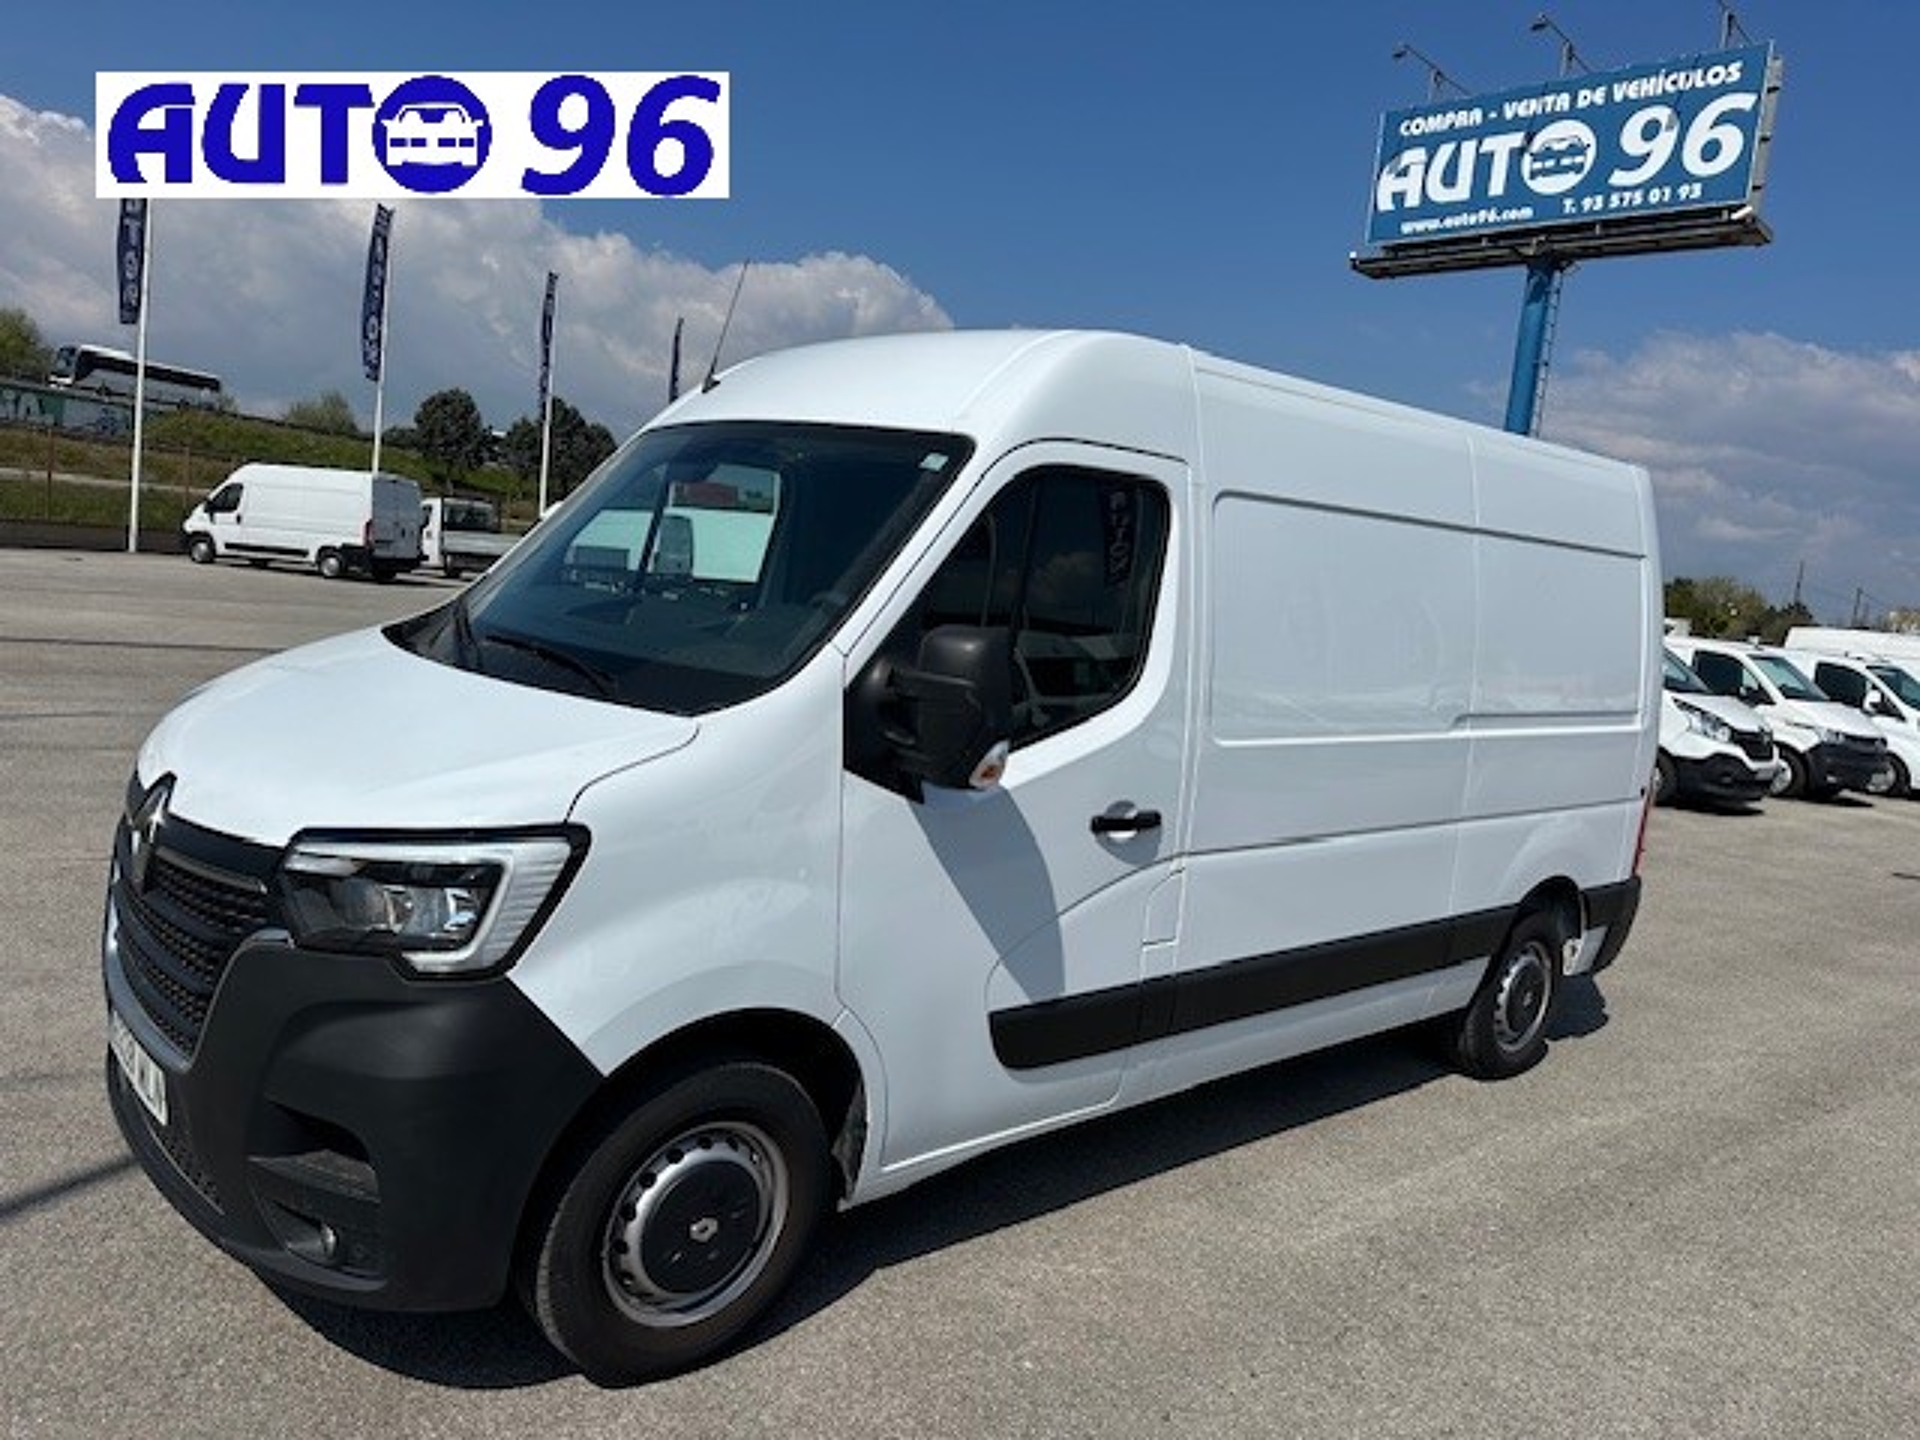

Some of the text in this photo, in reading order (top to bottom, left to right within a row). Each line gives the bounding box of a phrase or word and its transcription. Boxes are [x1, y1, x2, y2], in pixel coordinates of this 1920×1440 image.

[1400, 107, 1483, 136] COMPRA
[1502, 92, 1570, 120] VENTA
[1576, 86, 1607, 109] DE
[1612, 61, 1744, 103] VEHÍCULOS
[1376, 92, 1759, 212] AUTO 96
[1401, 207, 1534, 235] www.auto96.com
[1581, 196, 1603, 212] 93
[1608, 192, 1642, 209] 575
